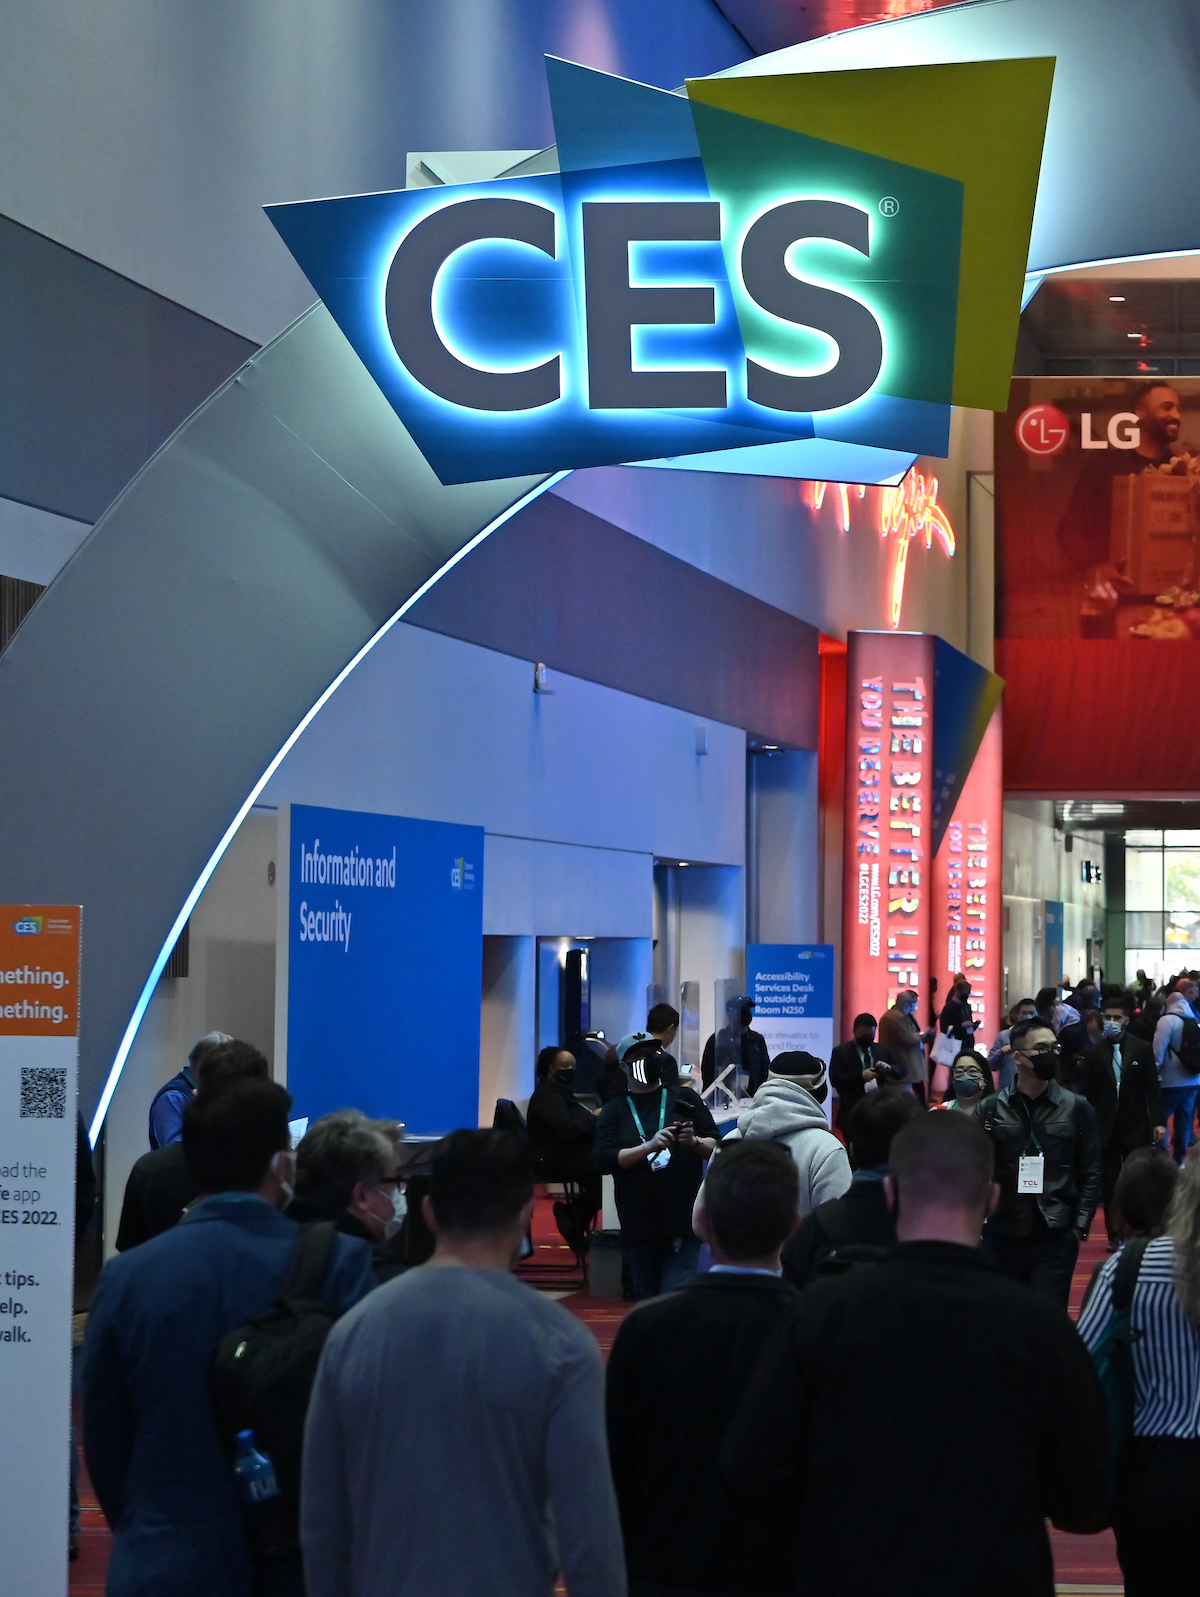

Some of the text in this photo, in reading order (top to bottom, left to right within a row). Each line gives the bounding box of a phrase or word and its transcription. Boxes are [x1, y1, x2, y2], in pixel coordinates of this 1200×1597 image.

[1081, 412, 1141, 450] LG
[890, 676, 928, 754] THE
[855, 675, 884, 855] YOU DESERVE
[887, 760, 924, 913] BETTER
[301, 838, 396, 888] Information and
[15, 921, 37, 933] CES
[300, 899, 352, 953] Security
[755, 971, 810, 982] Accessibility
[754, 983, 815, 992] Services Desk
[754, 994, 808, 1003] is outside of
[755, 1006, 805, 1014] Room N250
[22, 1161, 48, 1178] the
[13, 1190, 41, 1206] app
[22, 1210, 62, 1226] 2022.
[5, 1269, 40, 1290] tips.
